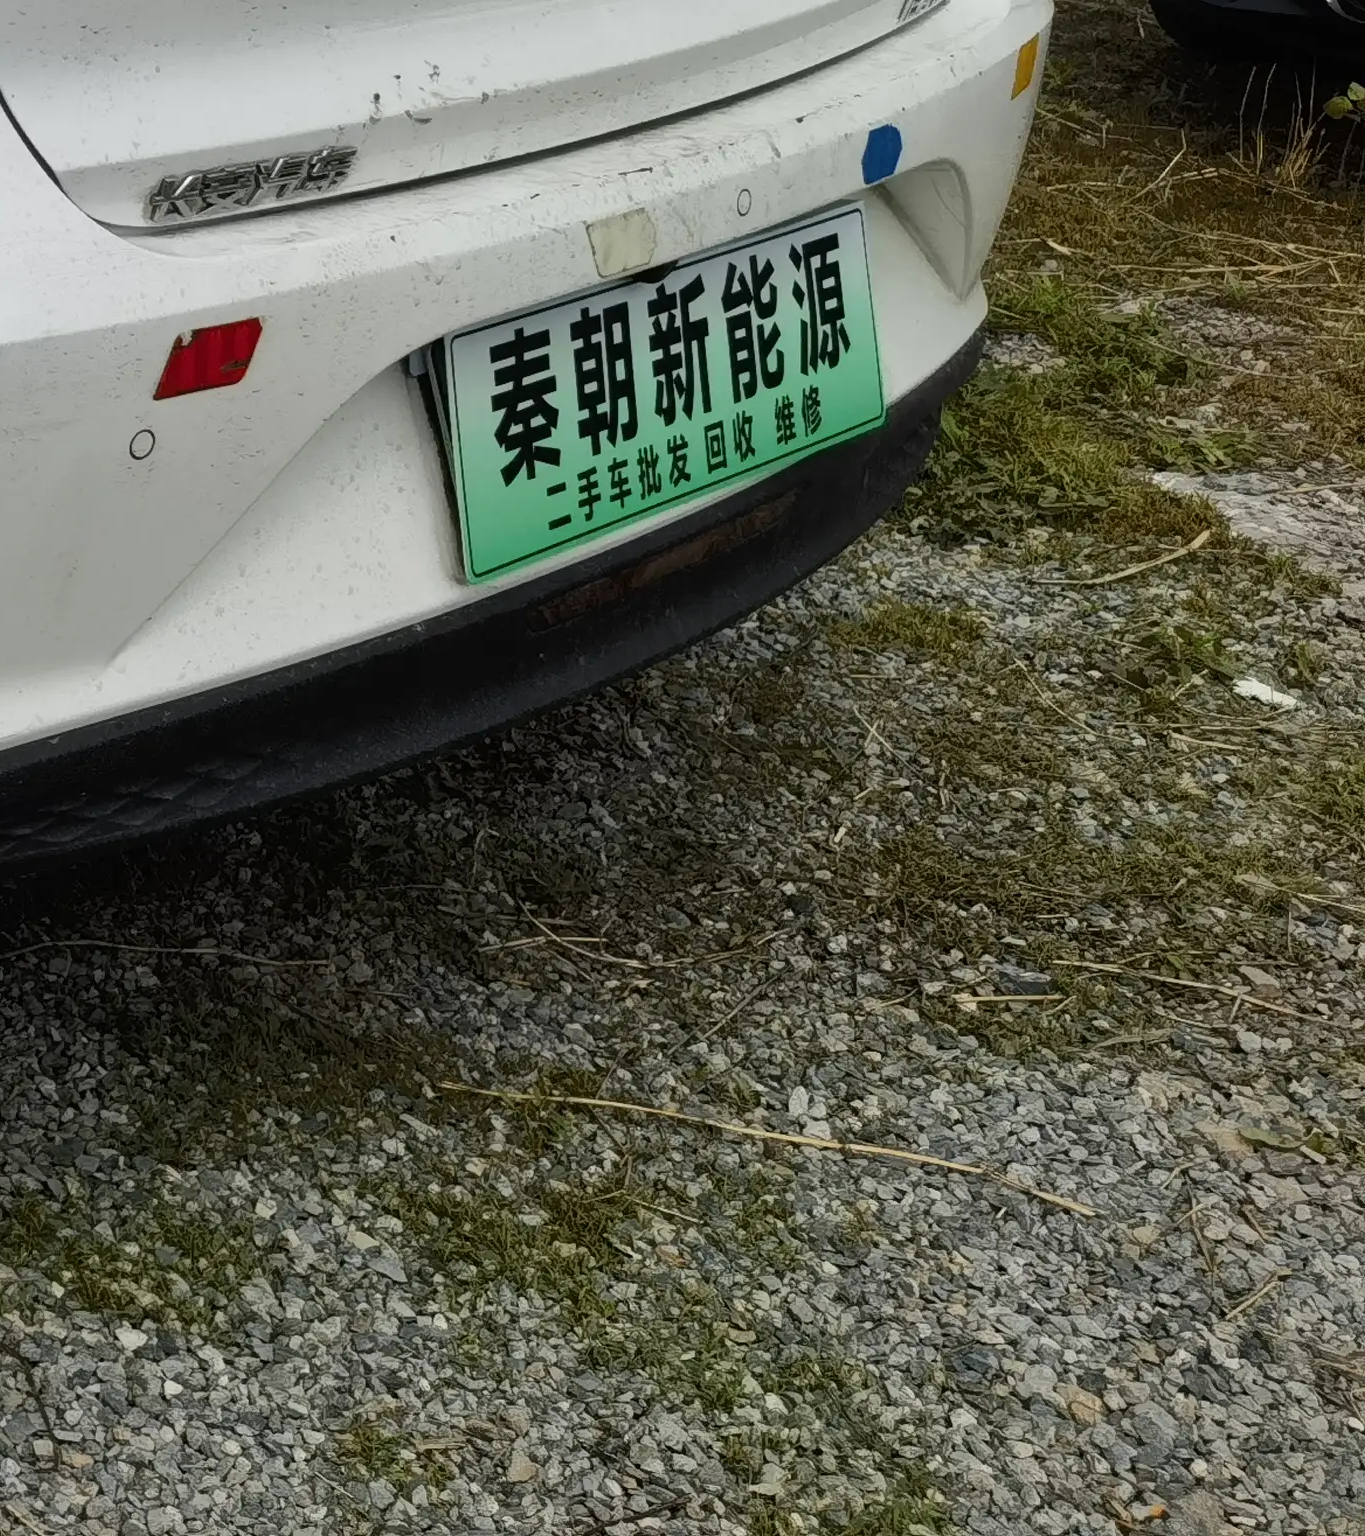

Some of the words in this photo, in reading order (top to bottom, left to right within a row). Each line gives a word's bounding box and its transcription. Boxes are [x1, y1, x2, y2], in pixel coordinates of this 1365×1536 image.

[489, 233, 851, 487] 秦朝新能源
[546, 432, 691, 531] 二手车批发
[704, 410, 756, 475] 回收
[774, 384, 822, 446] 维修
